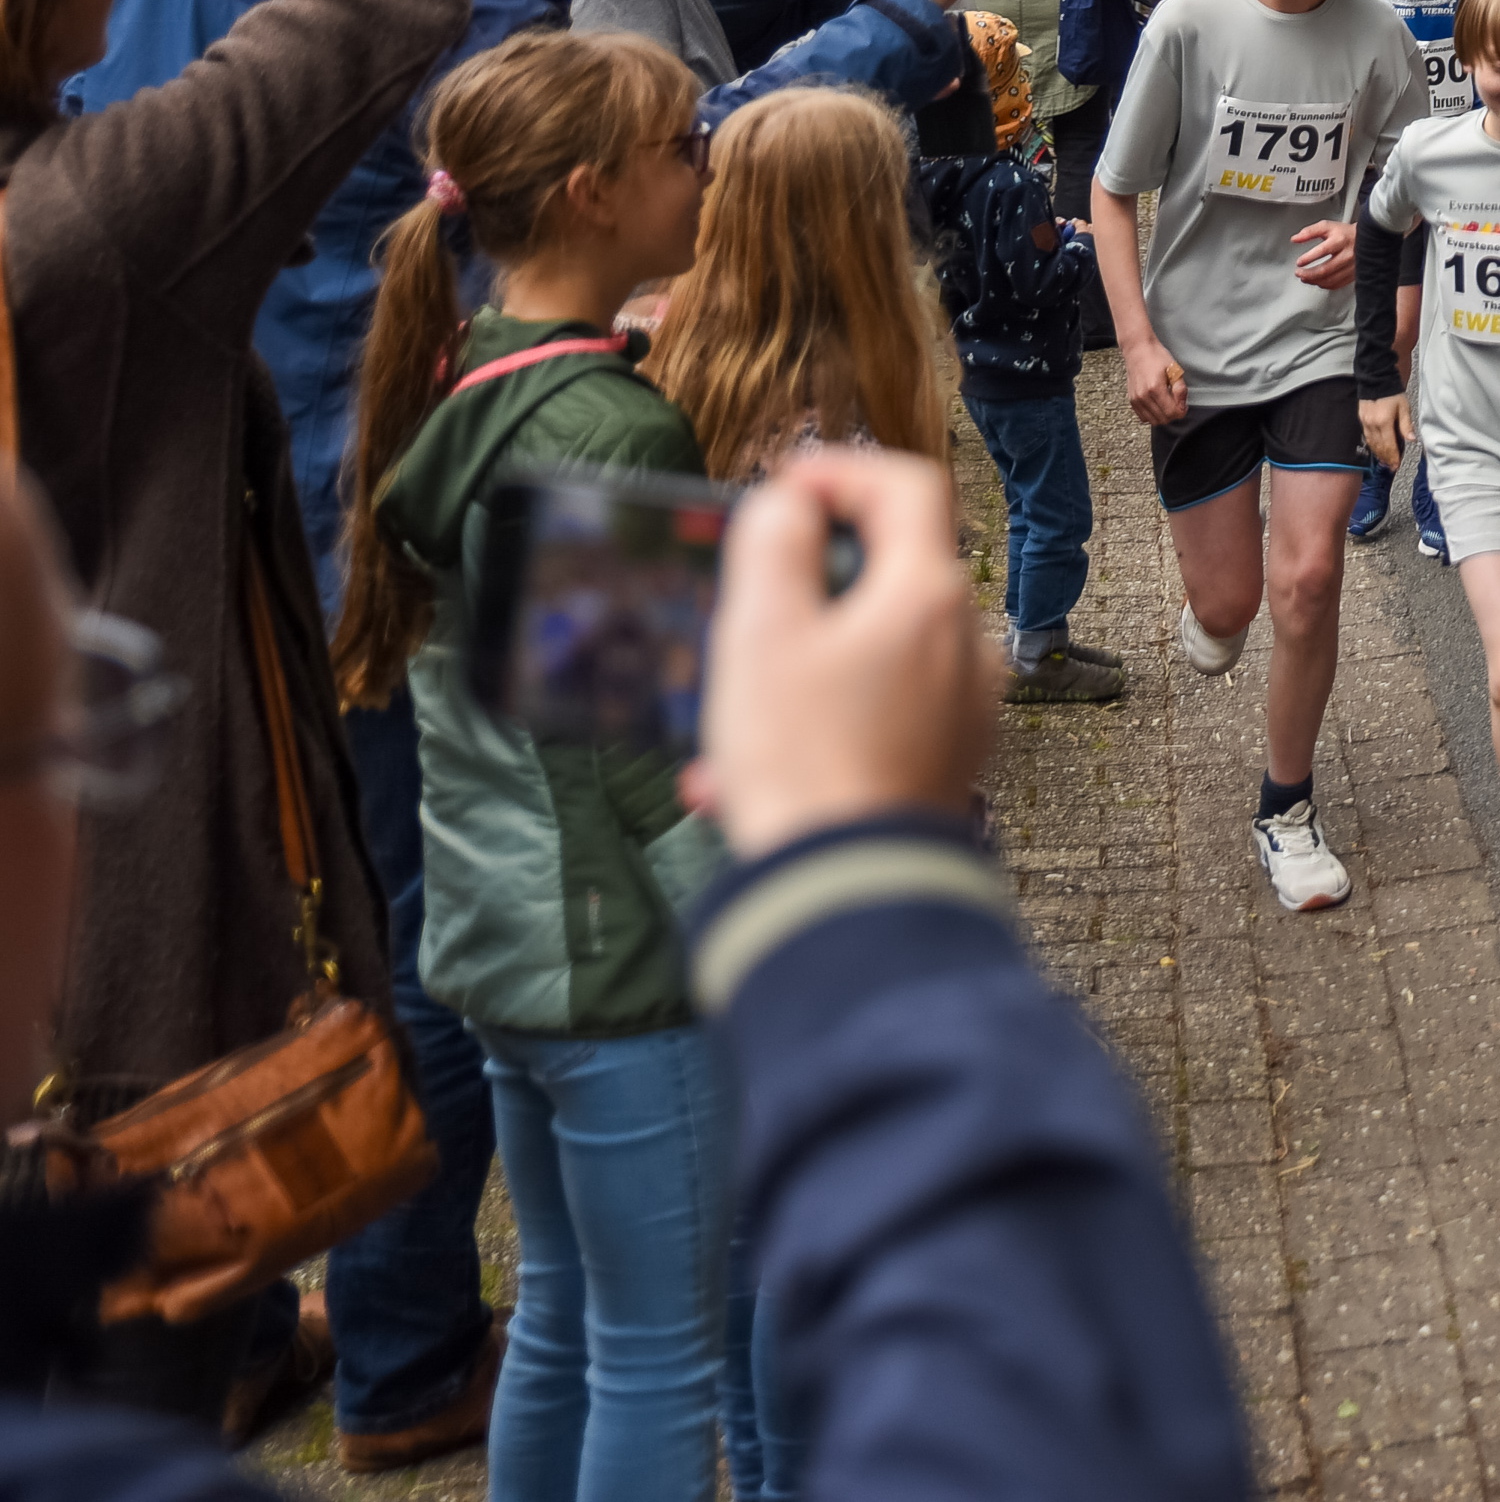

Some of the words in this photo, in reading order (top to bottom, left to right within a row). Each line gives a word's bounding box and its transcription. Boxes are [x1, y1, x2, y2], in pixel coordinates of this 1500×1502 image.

[1395, 7, 1416, 17] runs
[1425, 52, 1468, 86] 90
[1433, 95, 1466, 109] bruns
[1227, 106, 1287, 121] Everstener
[1289, 110, 1347, 121] Brunnenlauf
[1220, 119, 1345, 162] 1791
[1269, 165, 1296, 174] Jona
[1219, 169, 1276, 193] EWE
[1295, 175, 1336, 192] bruns
